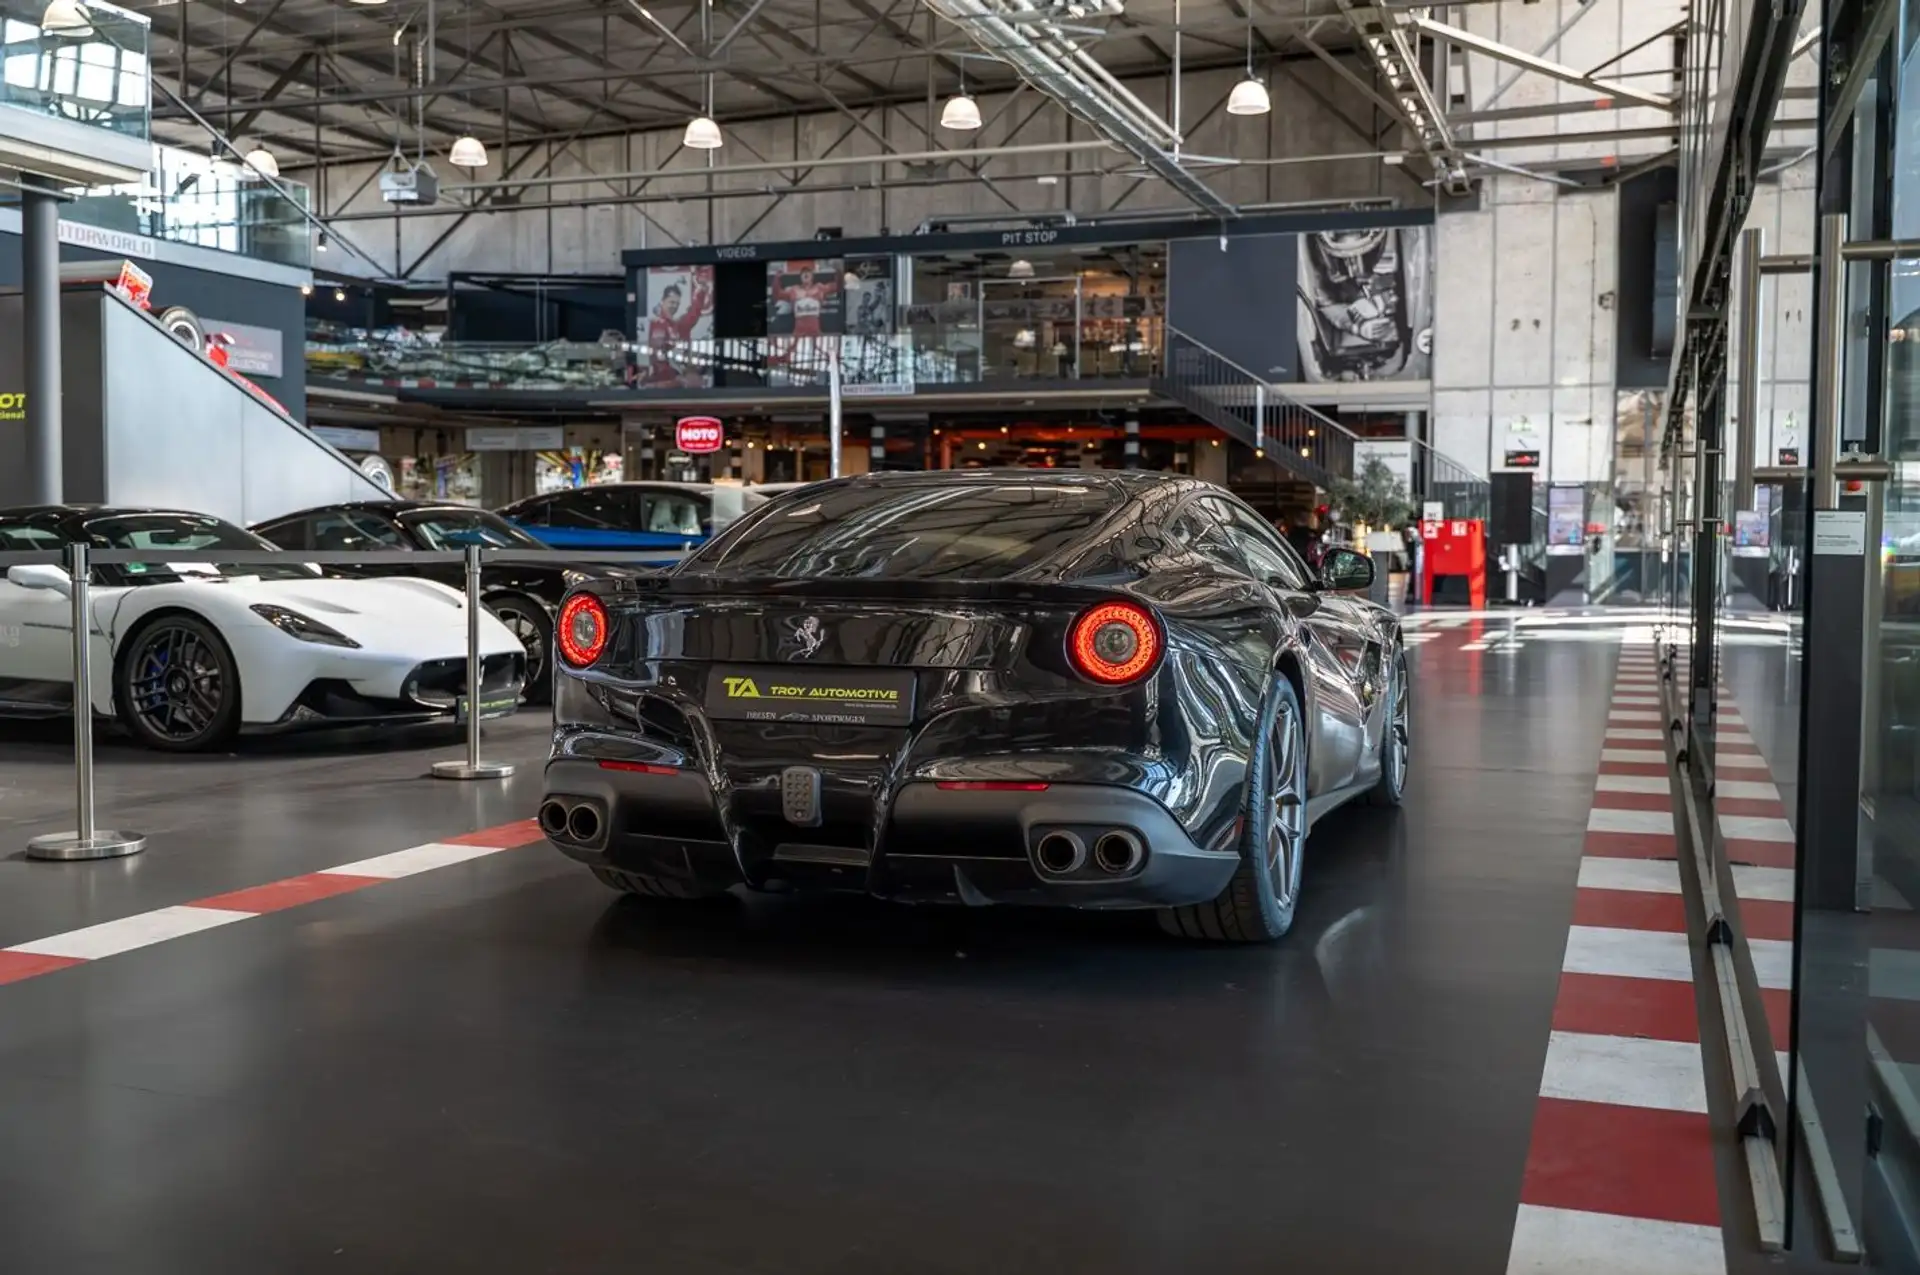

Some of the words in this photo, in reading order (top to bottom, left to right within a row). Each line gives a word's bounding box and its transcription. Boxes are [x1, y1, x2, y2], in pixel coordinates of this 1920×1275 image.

[1002, 232, 1021, 244] PIT
[1025, 231, 1057, 243] STOP
[716, 246, 756, 258] VIDEOS
[681, 428, 718, 441] MOTO
[723, 677, 760, 697] TA
[770, 686, 806, 696] TROY
[808, 687, 898, 699] AUTOMOTIVE
[811, 714, 866, 724] SPORTWAGEN
